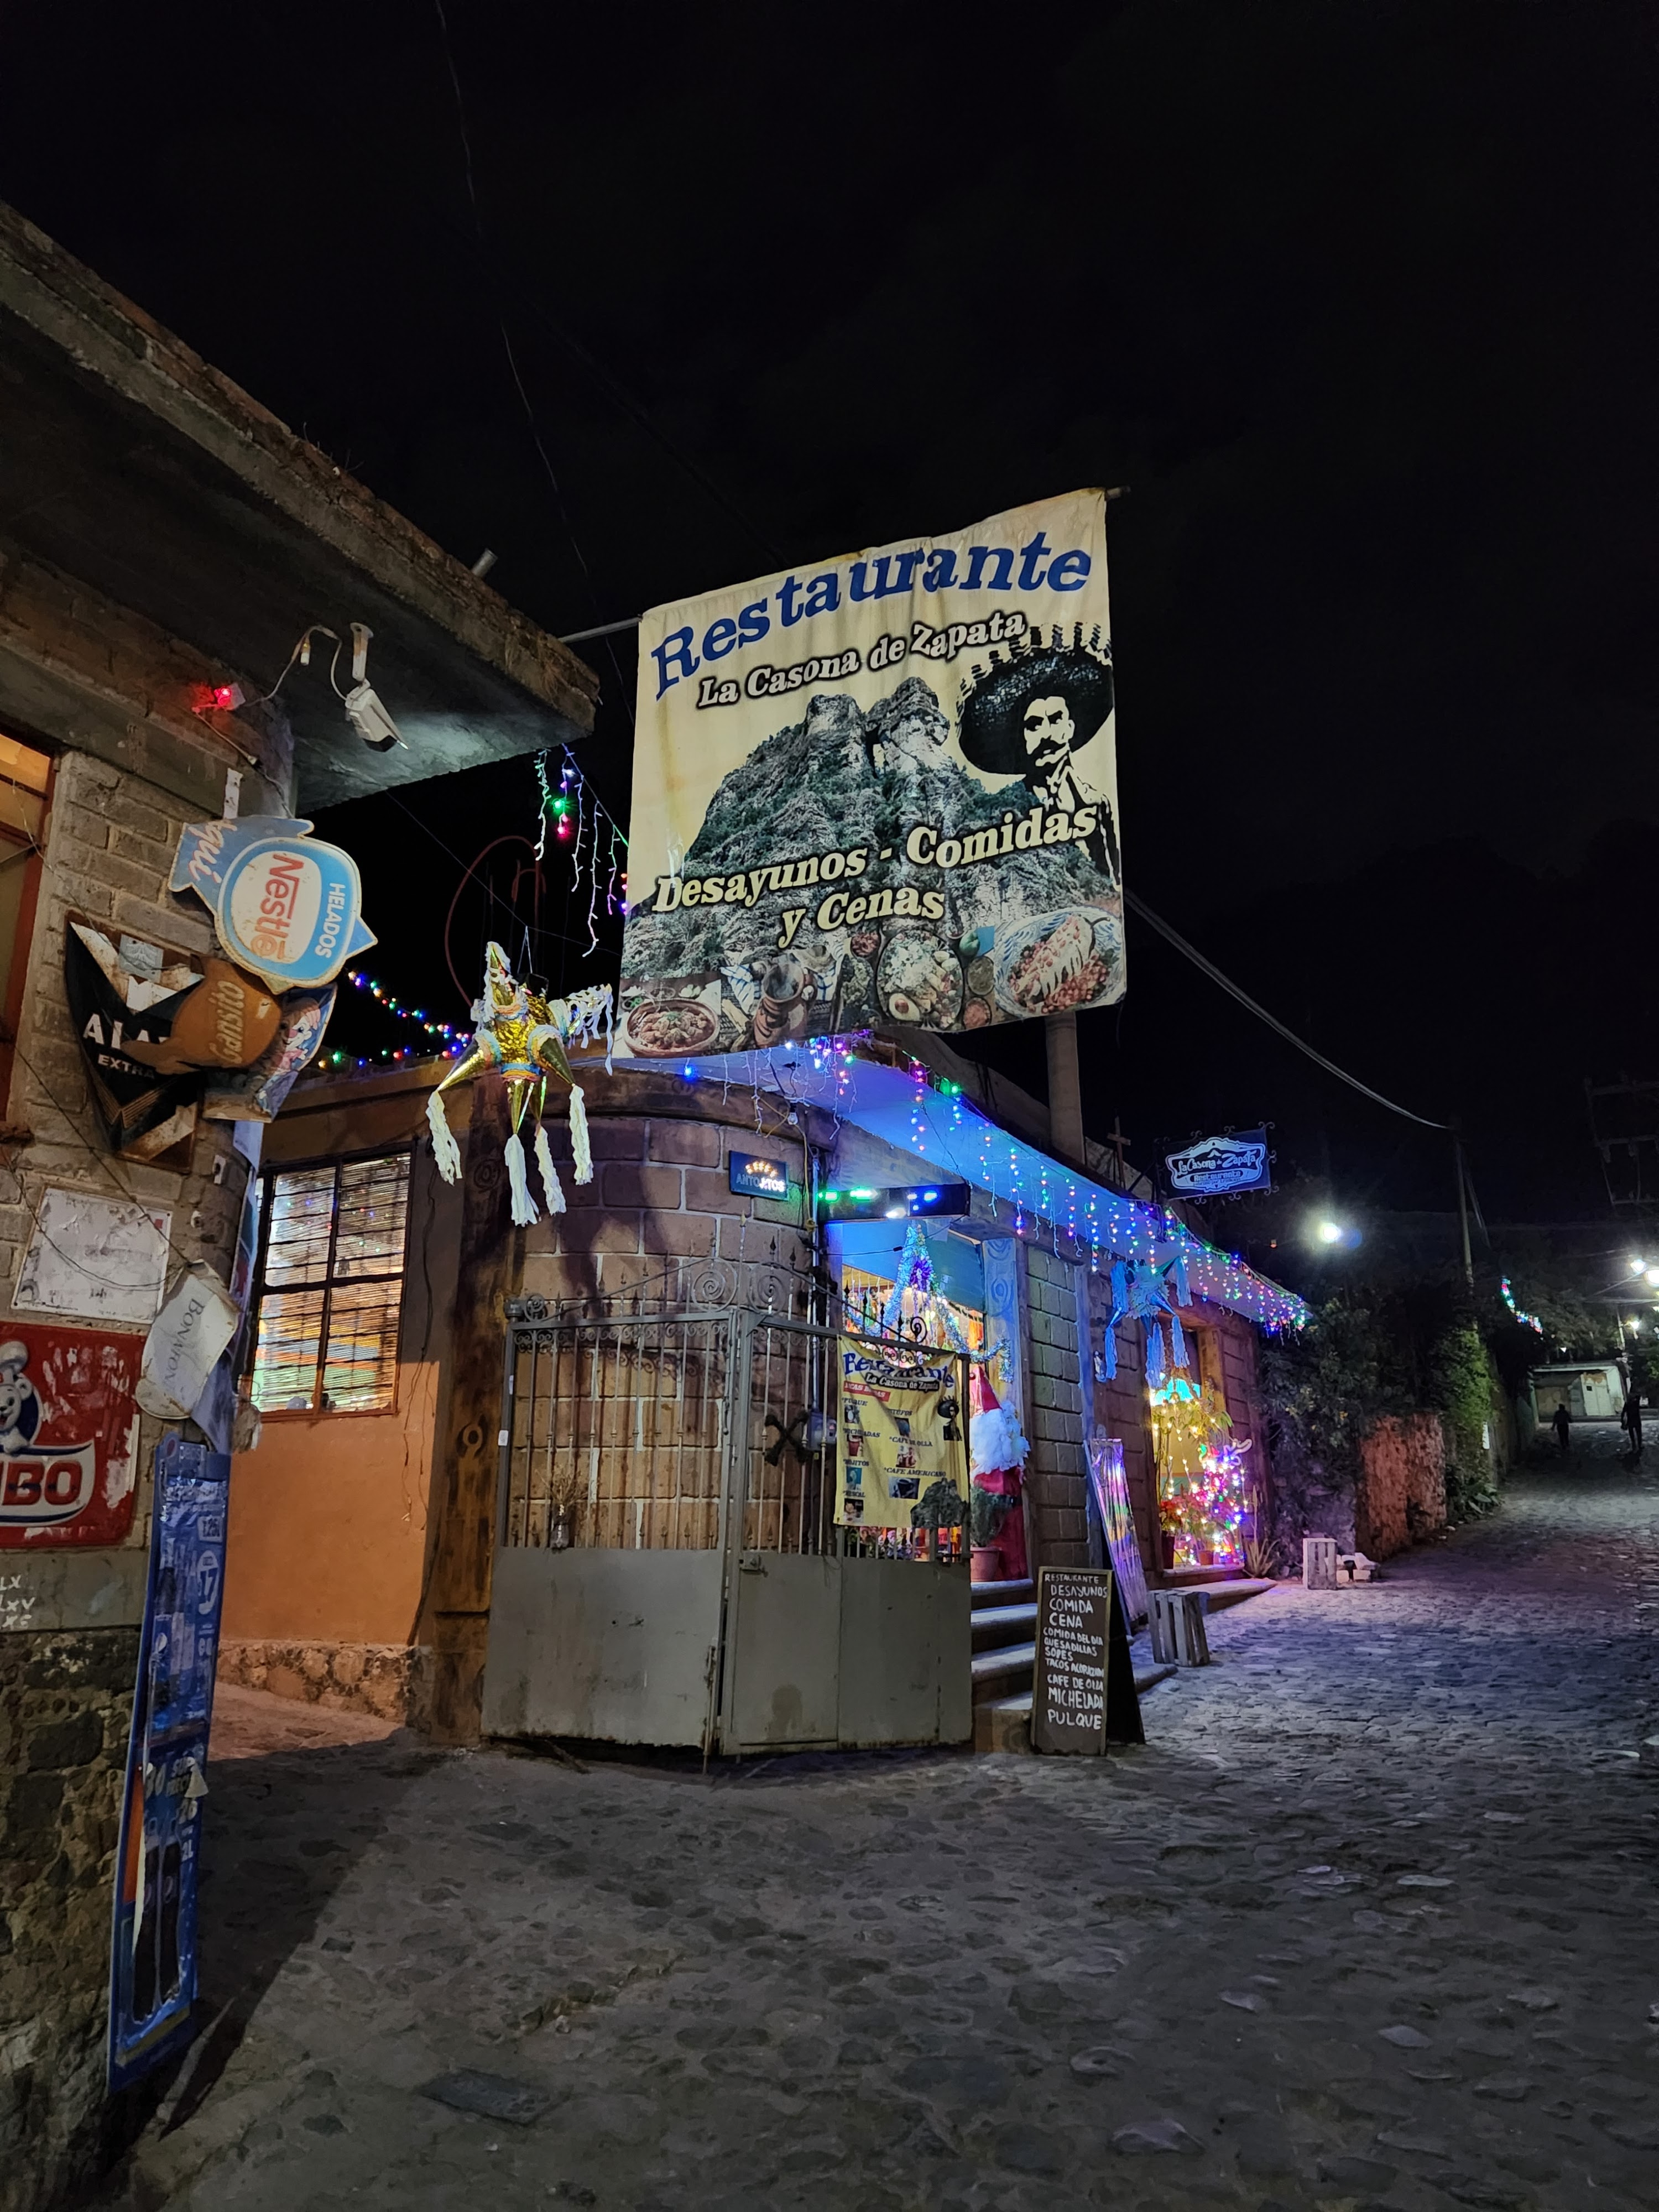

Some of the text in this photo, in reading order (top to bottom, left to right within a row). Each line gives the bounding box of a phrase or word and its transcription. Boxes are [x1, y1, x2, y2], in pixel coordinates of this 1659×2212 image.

[651, 531, 1092, 701] Restaurante
[697, 613, 1025, 708] La Casona de Zapata
[652, 848, 868, 911] Desayunos
[907, 805, 1099, 868] Comidas
[250, 853, 305, 959] Nestlé
[314, 883, 346, 958] HELADOS
[778, 888, 945, 948] y Cenas
[208, 980, 244, 1065] Gansito
[97, 1053, 155, 1079] EXTRA
[1178, 1160, 1188, 1176] La
[1187, 1158, 1217, 1172] Casona
[1222, 1150, 1257, 1168] Zapata
[735, 1173, 785, 1192] ANTOJITOS
[866, 1373, 877, 1383] La
[879, 1375, 908, 1389] Casona
[0, 1460, 83, 1506] BO
[1045, 1573, 1099, 1584] RESTAURANTE
[1050, 1584, 1108, 1599] DESAYUNOS
[1049, 1598, 1094, 1614] COMIDA
[1049, 1612, 1083, 1629] CENA
[1043, 1626, 1076, 1641] COMIDA
[1077, 1632, 1091, 1644] DEL
[1044, 1637, 1097, 1657] QUESADILLAS
[1045, 1646, 1073, 1662] SOPES
[1045, 1657, 1070, 1672] TACOS
[1047, 1674, 1069, 1688] CAFE
[1072, 1677, 1084, 1690] DE
[1047, 1708, 1102, 1730] PULQUE
